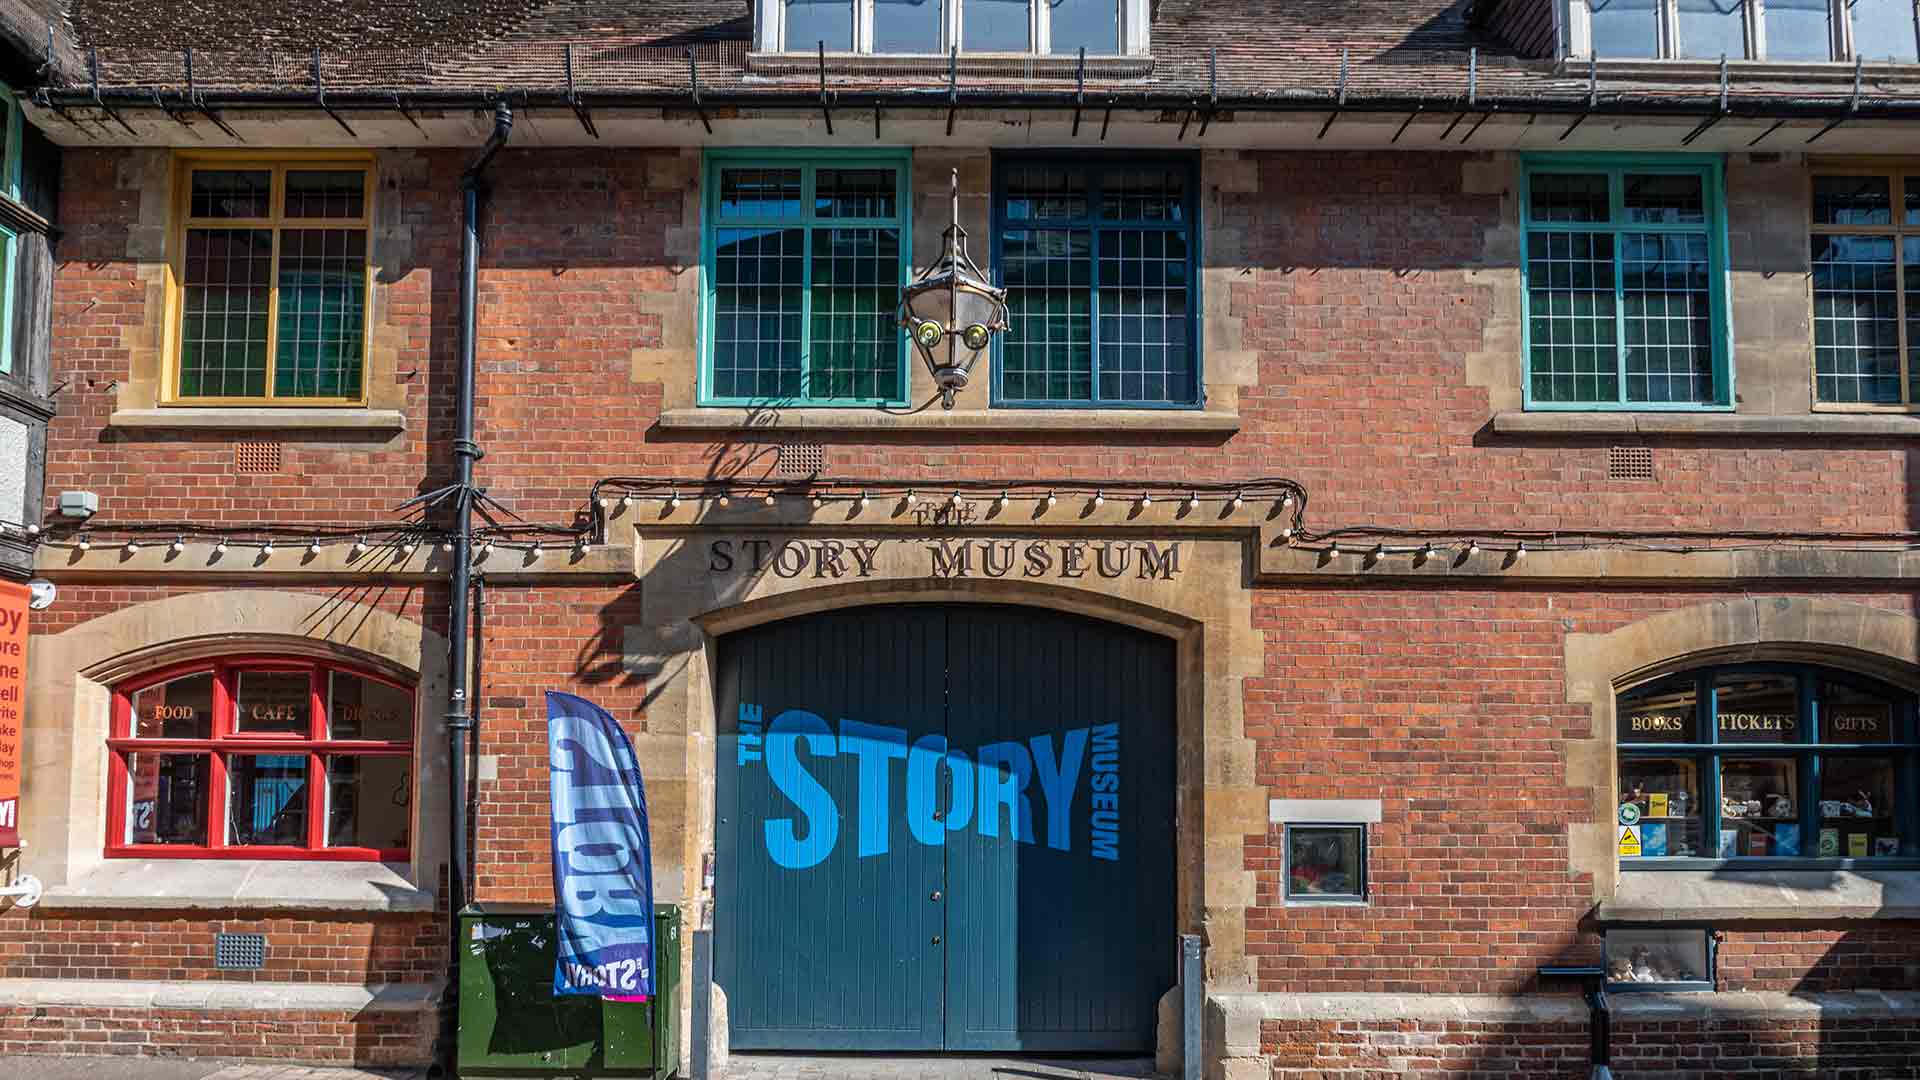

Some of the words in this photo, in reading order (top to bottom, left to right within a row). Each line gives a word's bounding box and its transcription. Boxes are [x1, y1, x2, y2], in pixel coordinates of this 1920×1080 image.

[911, 502, 977, 527] THE
[709, 538, 884, 576] STORY
[930, 539, 1183, 577] MUSEUM
[154, 705, 193, 720] FOOD
[252, 704, 296, 720] CAFE
[1717, 713, 1795, 730] TICKETS
[1632, 716, 1683, 731] BOOKS
[1834, 717, 1877, 731] GIFTS
[737, 703, 762, 766] THE
[764, 710, 1090, 868] STORY
[1091, 721, 1119, 861] MUSEUM
